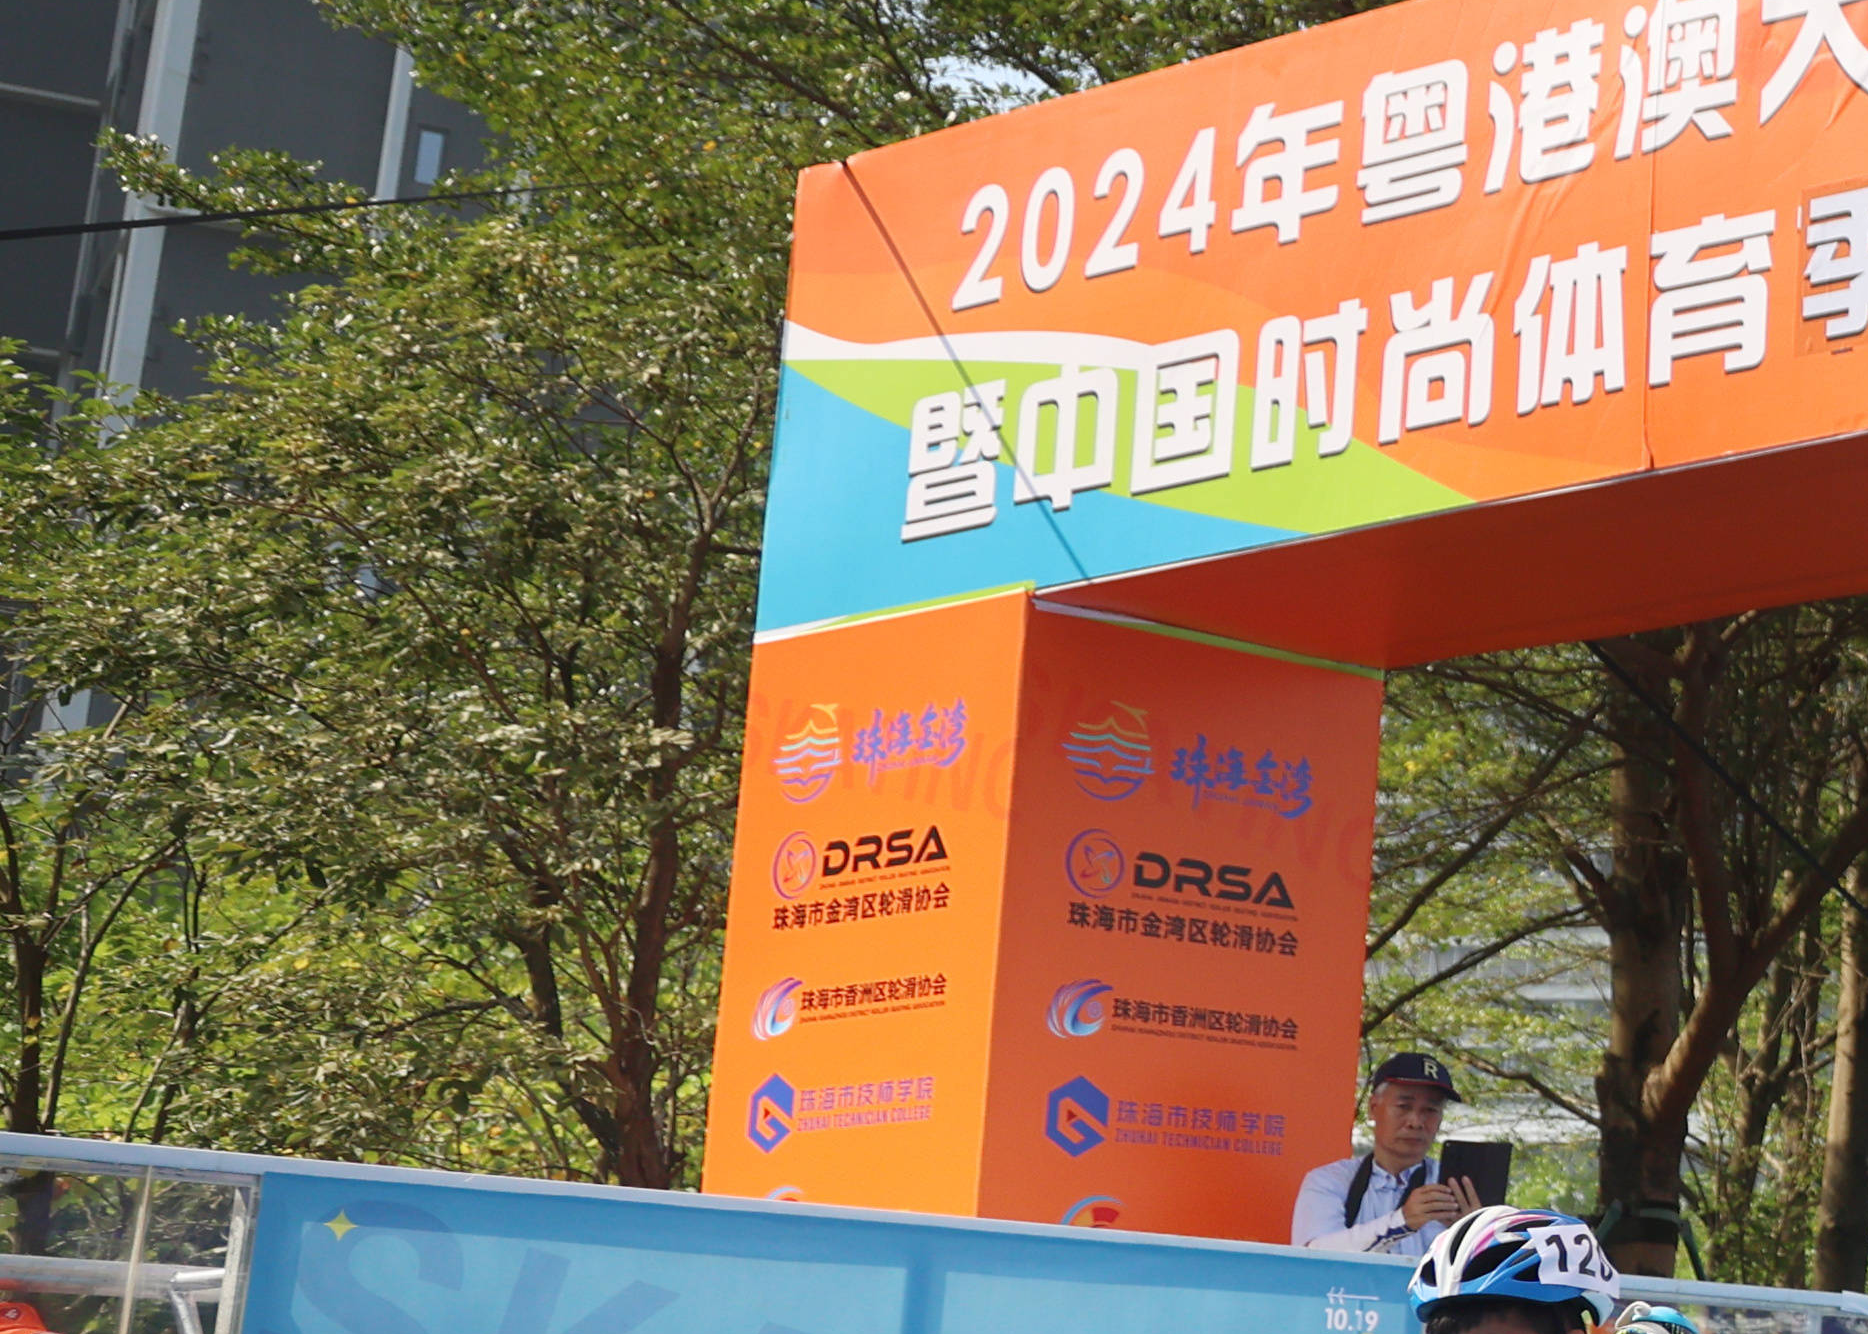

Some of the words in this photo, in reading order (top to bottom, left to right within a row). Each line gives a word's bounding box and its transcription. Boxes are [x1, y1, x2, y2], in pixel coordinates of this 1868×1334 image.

[821, 824, 948, 878] DRSA
[1133, 851, 1295, 909] DRSA
[772, 881, 951, 931] 珠海市金湾区轮滑协会
[1066, 901, 1299, 957] 珠海市金湾区轮滑协会
[1111, 997, 1299, 1040] 珠海市香洲区轮滑协会
[1423, 1058, 1439, 1080] R
[1117, 1099, 1286, 1138] 珠海市技师学院
[1324, 1308, 1379, 1333] 10.19
